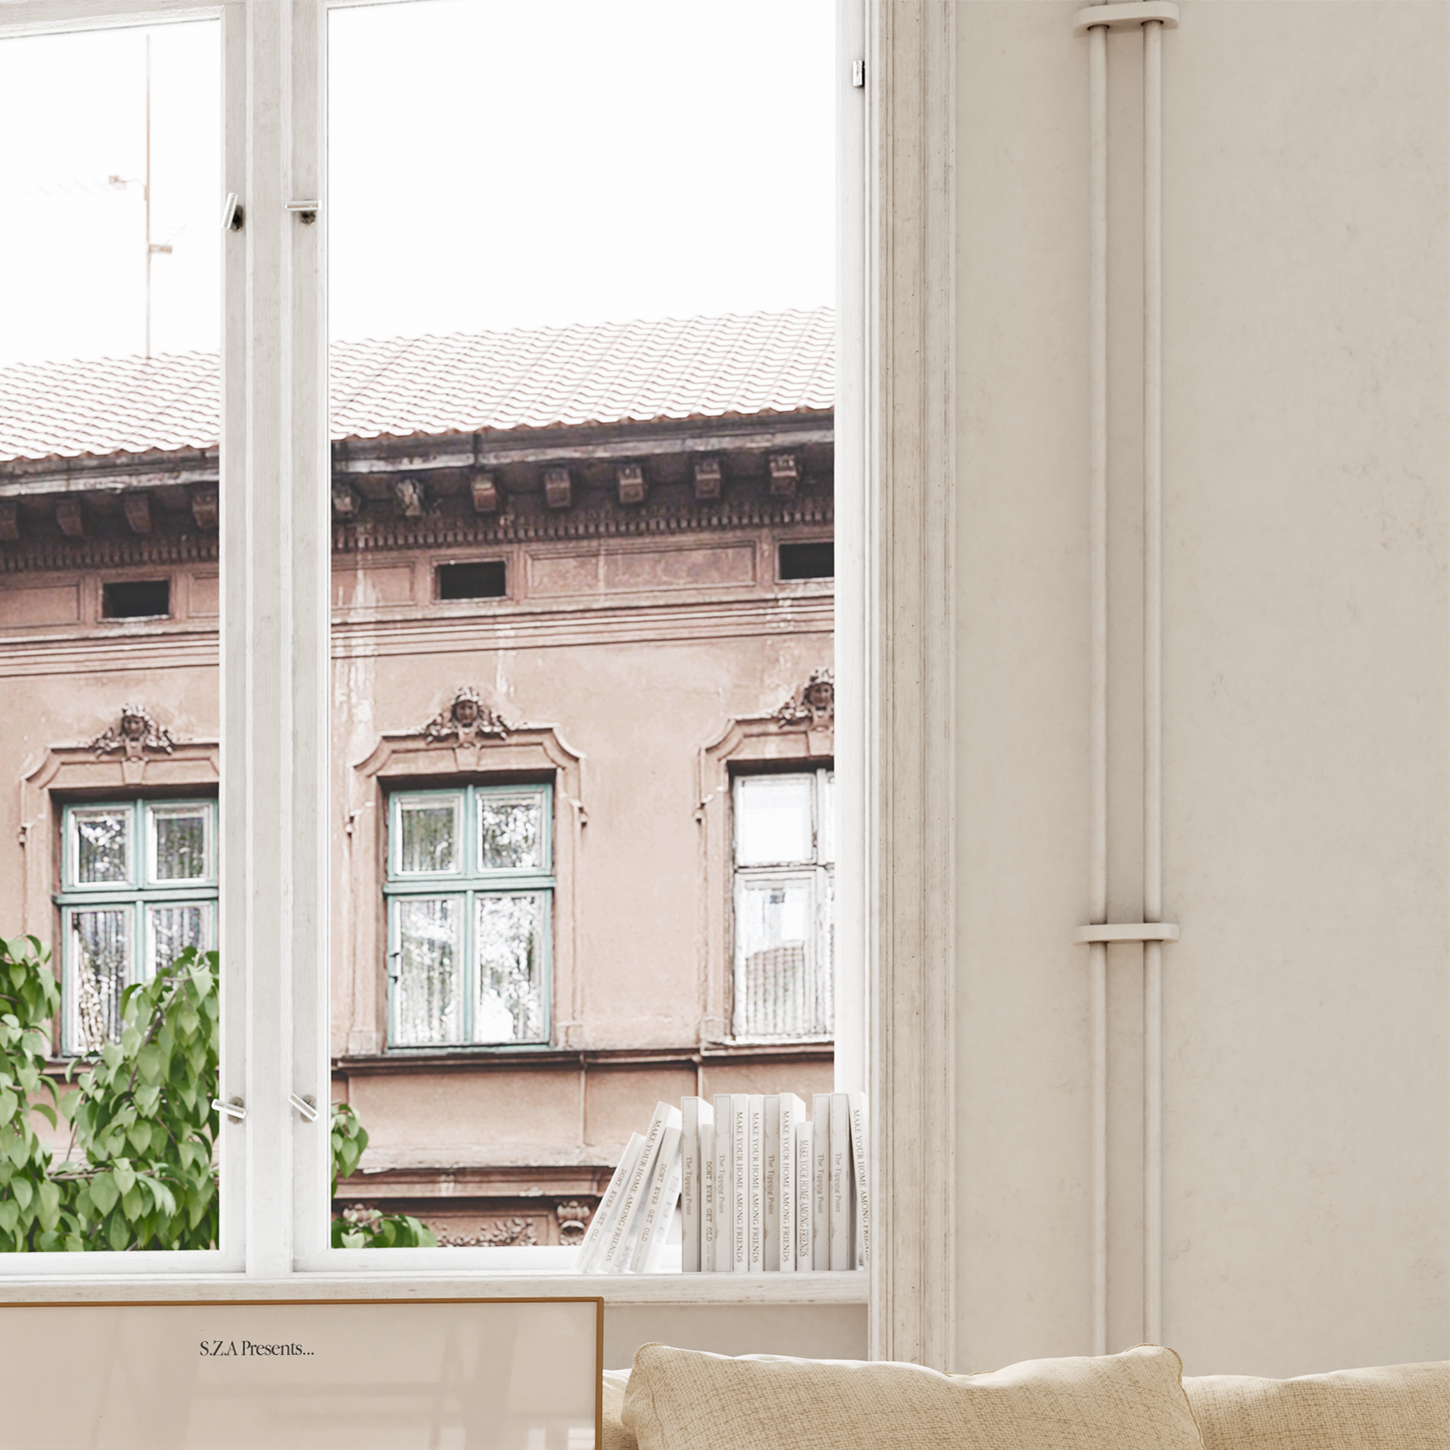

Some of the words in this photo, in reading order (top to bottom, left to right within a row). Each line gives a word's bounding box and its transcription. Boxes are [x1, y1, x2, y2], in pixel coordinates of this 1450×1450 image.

[648, 1119, 661, 1142] MAKE
[639, 1144, 653, 1167] YOUR
[799, 1140, 808, 1158] MAKE
[629, 1168, 644, 1193] HOME
[657, 1164, 667, 1182] DONT
[799, 1160, 808, 1179] YOUR
[650, 1187, 660, 1205] EVER
[799, 1180, 808, 1201] HOME
[618, 1195, 634, 1227] AMONG
[646, 1209, 654, 1224] GET
[799, 1202, 808, 1227] AMONG
[860, 1190, 869, 1222] AMONG
[605, 1227, 622, 1262] FRIENDS
[799, 1229, 808, 1257] FRIENDS
[200, 1339, 237, 1357] S.Z.A
[241, 1339, 315, 1358] Presents...
